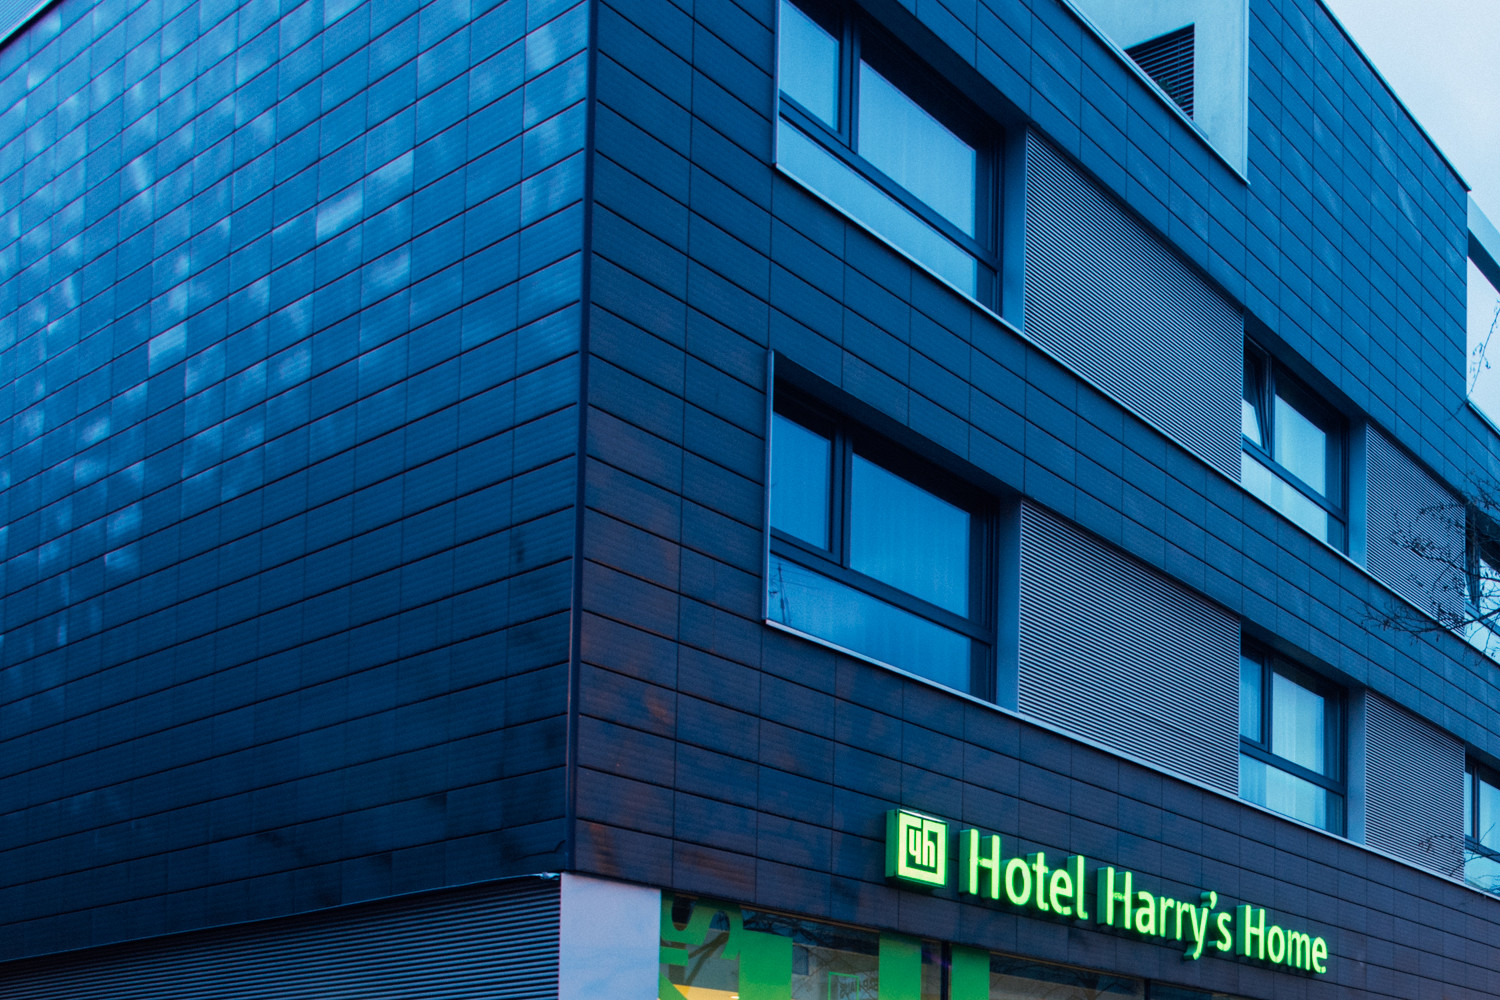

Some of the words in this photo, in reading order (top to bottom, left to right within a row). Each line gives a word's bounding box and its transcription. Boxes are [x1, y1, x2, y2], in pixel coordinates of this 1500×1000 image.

[966, 827, 1089, 921] Hotel
[1104, 865, 1232, 961] Harry's
[1243, 903, 1329, 974] Home
